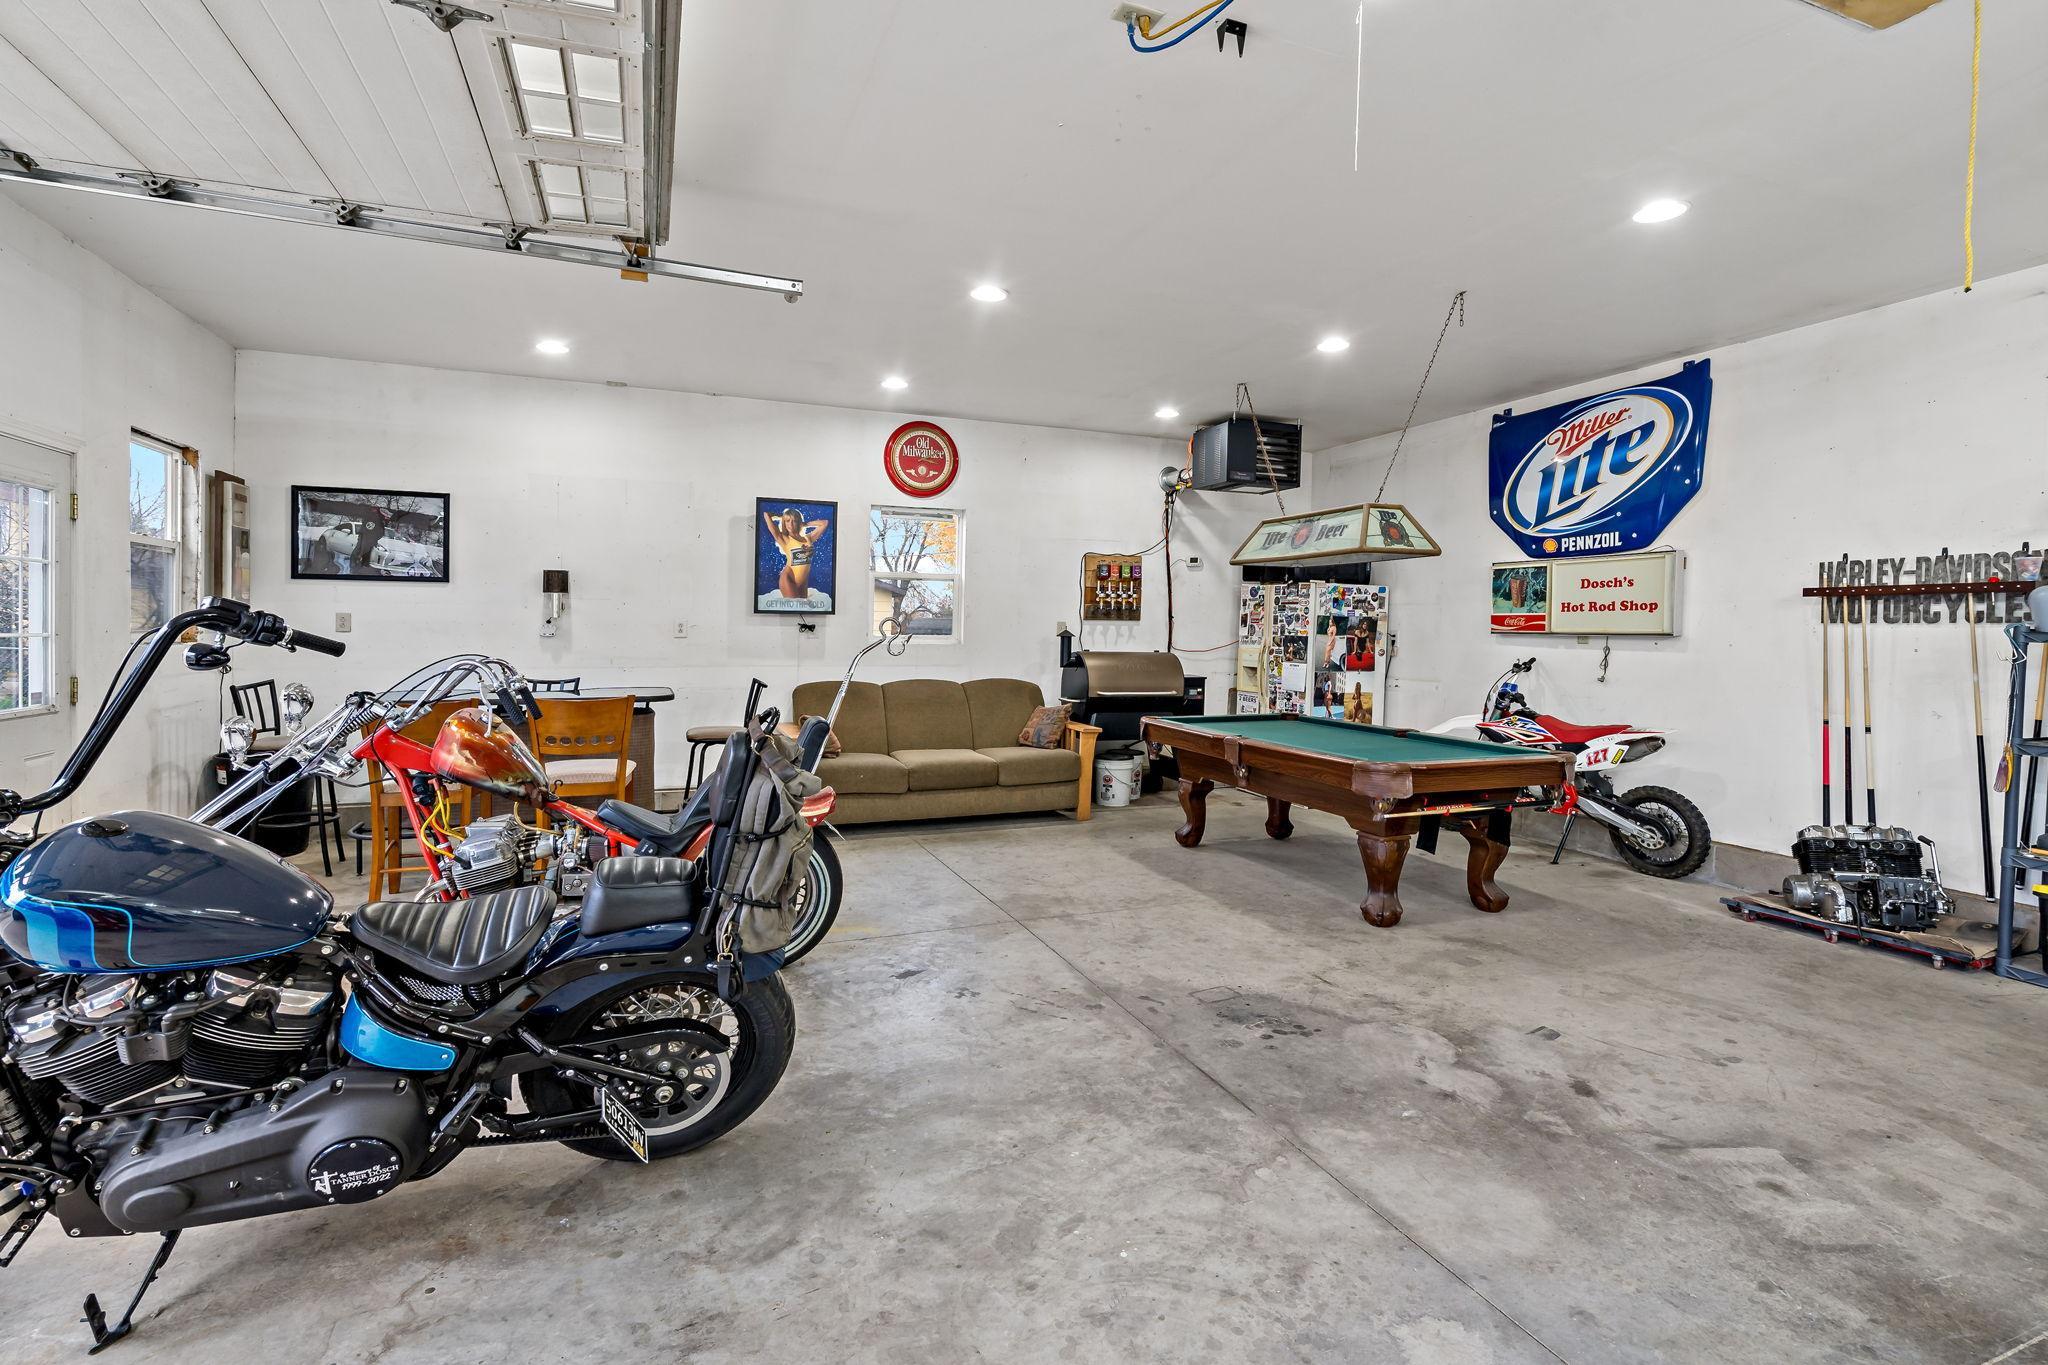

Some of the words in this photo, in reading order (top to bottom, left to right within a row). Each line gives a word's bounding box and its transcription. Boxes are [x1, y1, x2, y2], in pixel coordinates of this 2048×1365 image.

[1546, 407, 1631, 457] Miller
[902, 444, 945, 459] Milwaukee
[915, 437, 930, 449] Old
[1530, 420, 1656, 530] Lite
[1261, 531, 1288, 549] Lite
[1314, 523, 1349, 543] Beer
[1561, 531, 1623, 553] PENNZOIL
[1580, 576, 1635, 590] Dosch's
[765, 600, 779, 608] GET
[780, 600, 795, 608] INTO
[1560, 602, 1585, 613] Hot
[1588, 601, 1616, 613] Rod
[1619, 600, 1659, 614] Shop
[330, 1173, 368, 1186] TANNER
[368, 1164, 400, 1177] DOSCH
